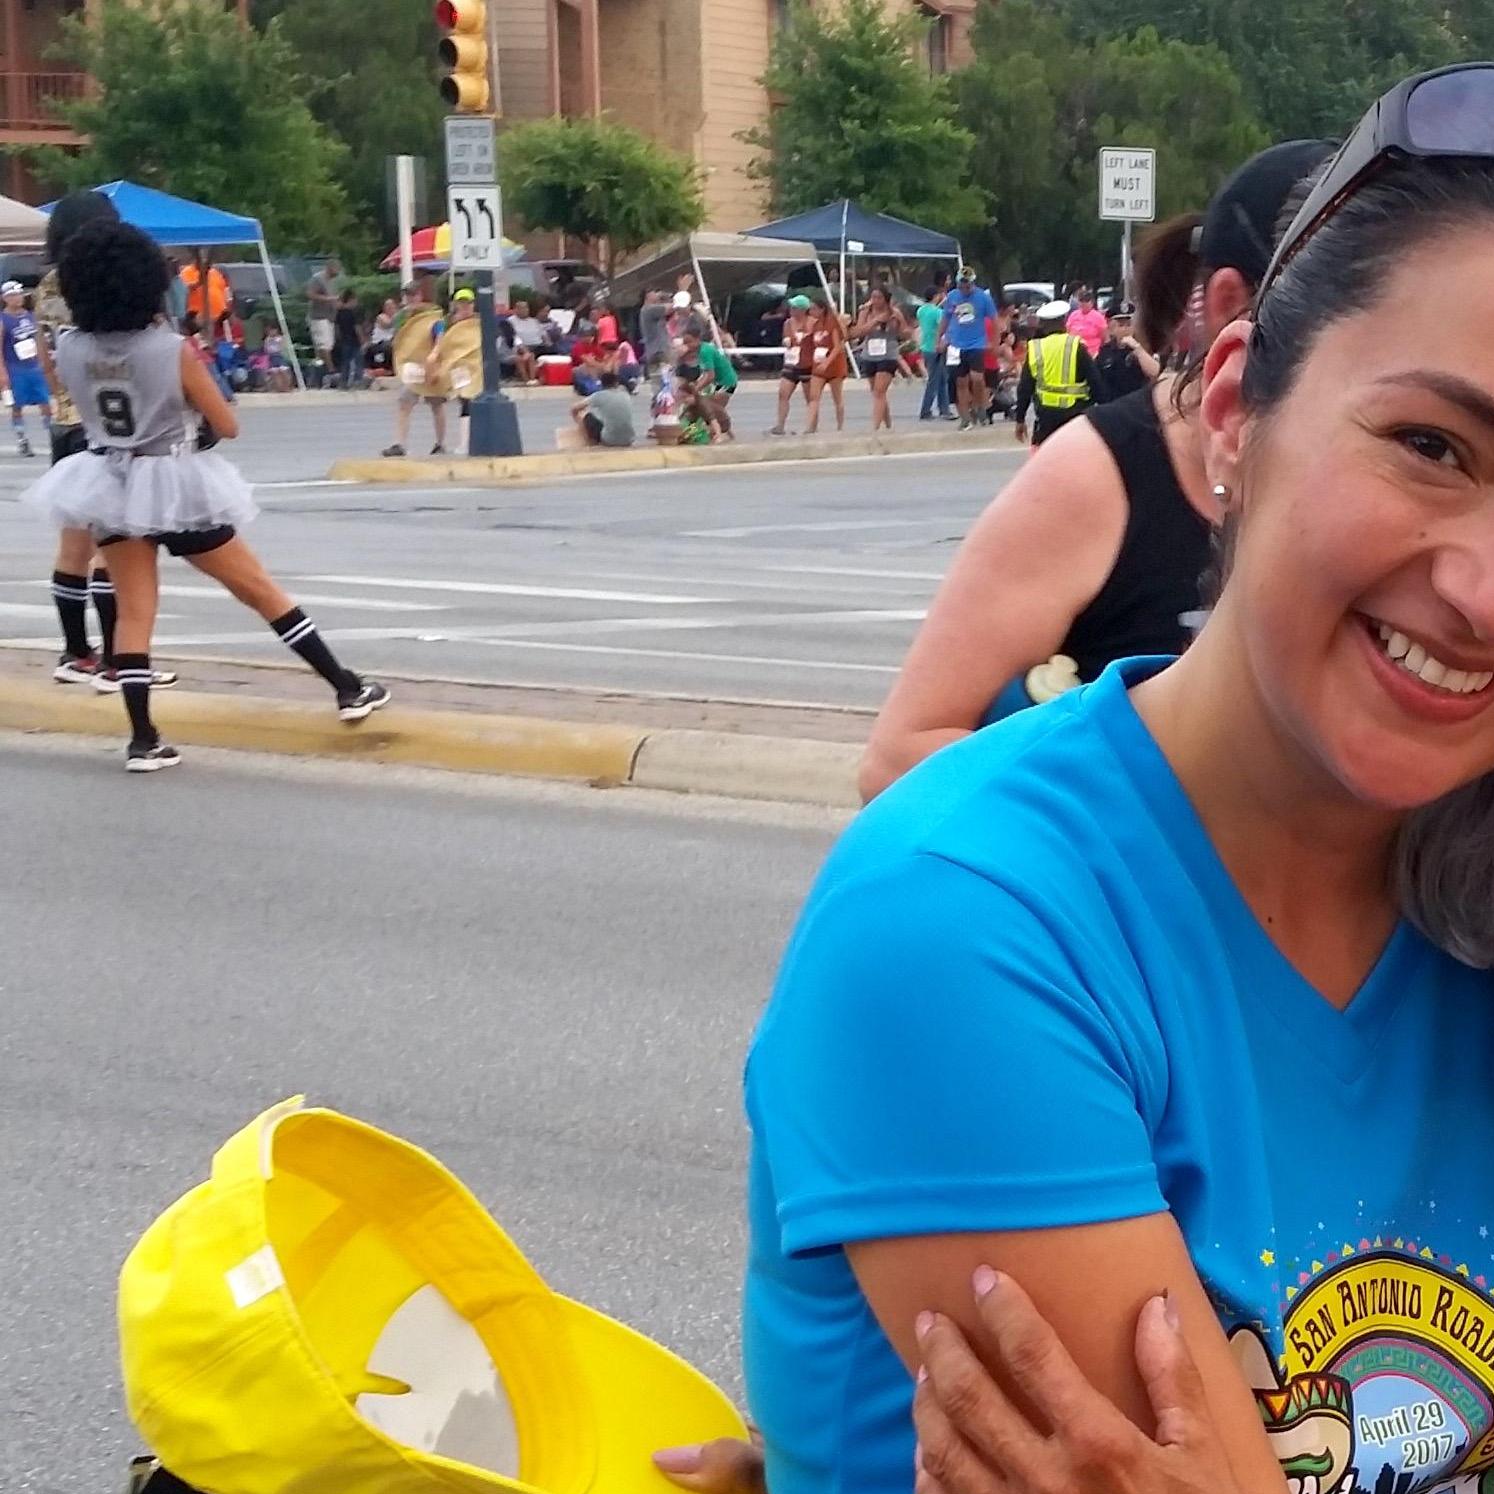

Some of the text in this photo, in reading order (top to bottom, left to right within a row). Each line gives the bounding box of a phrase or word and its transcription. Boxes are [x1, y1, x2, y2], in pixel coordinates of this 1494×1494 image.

[1105, 157, 1151, 170] LEFT LANE
[1113, 176, 1141, 191] MUST
[1129, 199, 1150, 210] LEFT
[96, 388, 136, 438] 9
[1289, 1304, 1338, 1368] SAN
[1336, 1277, 1423, 1328] ANTONIO
[1358, 1401, 1445, 1446] April 29
[1402, 1434, 1455, 1469] 2017
